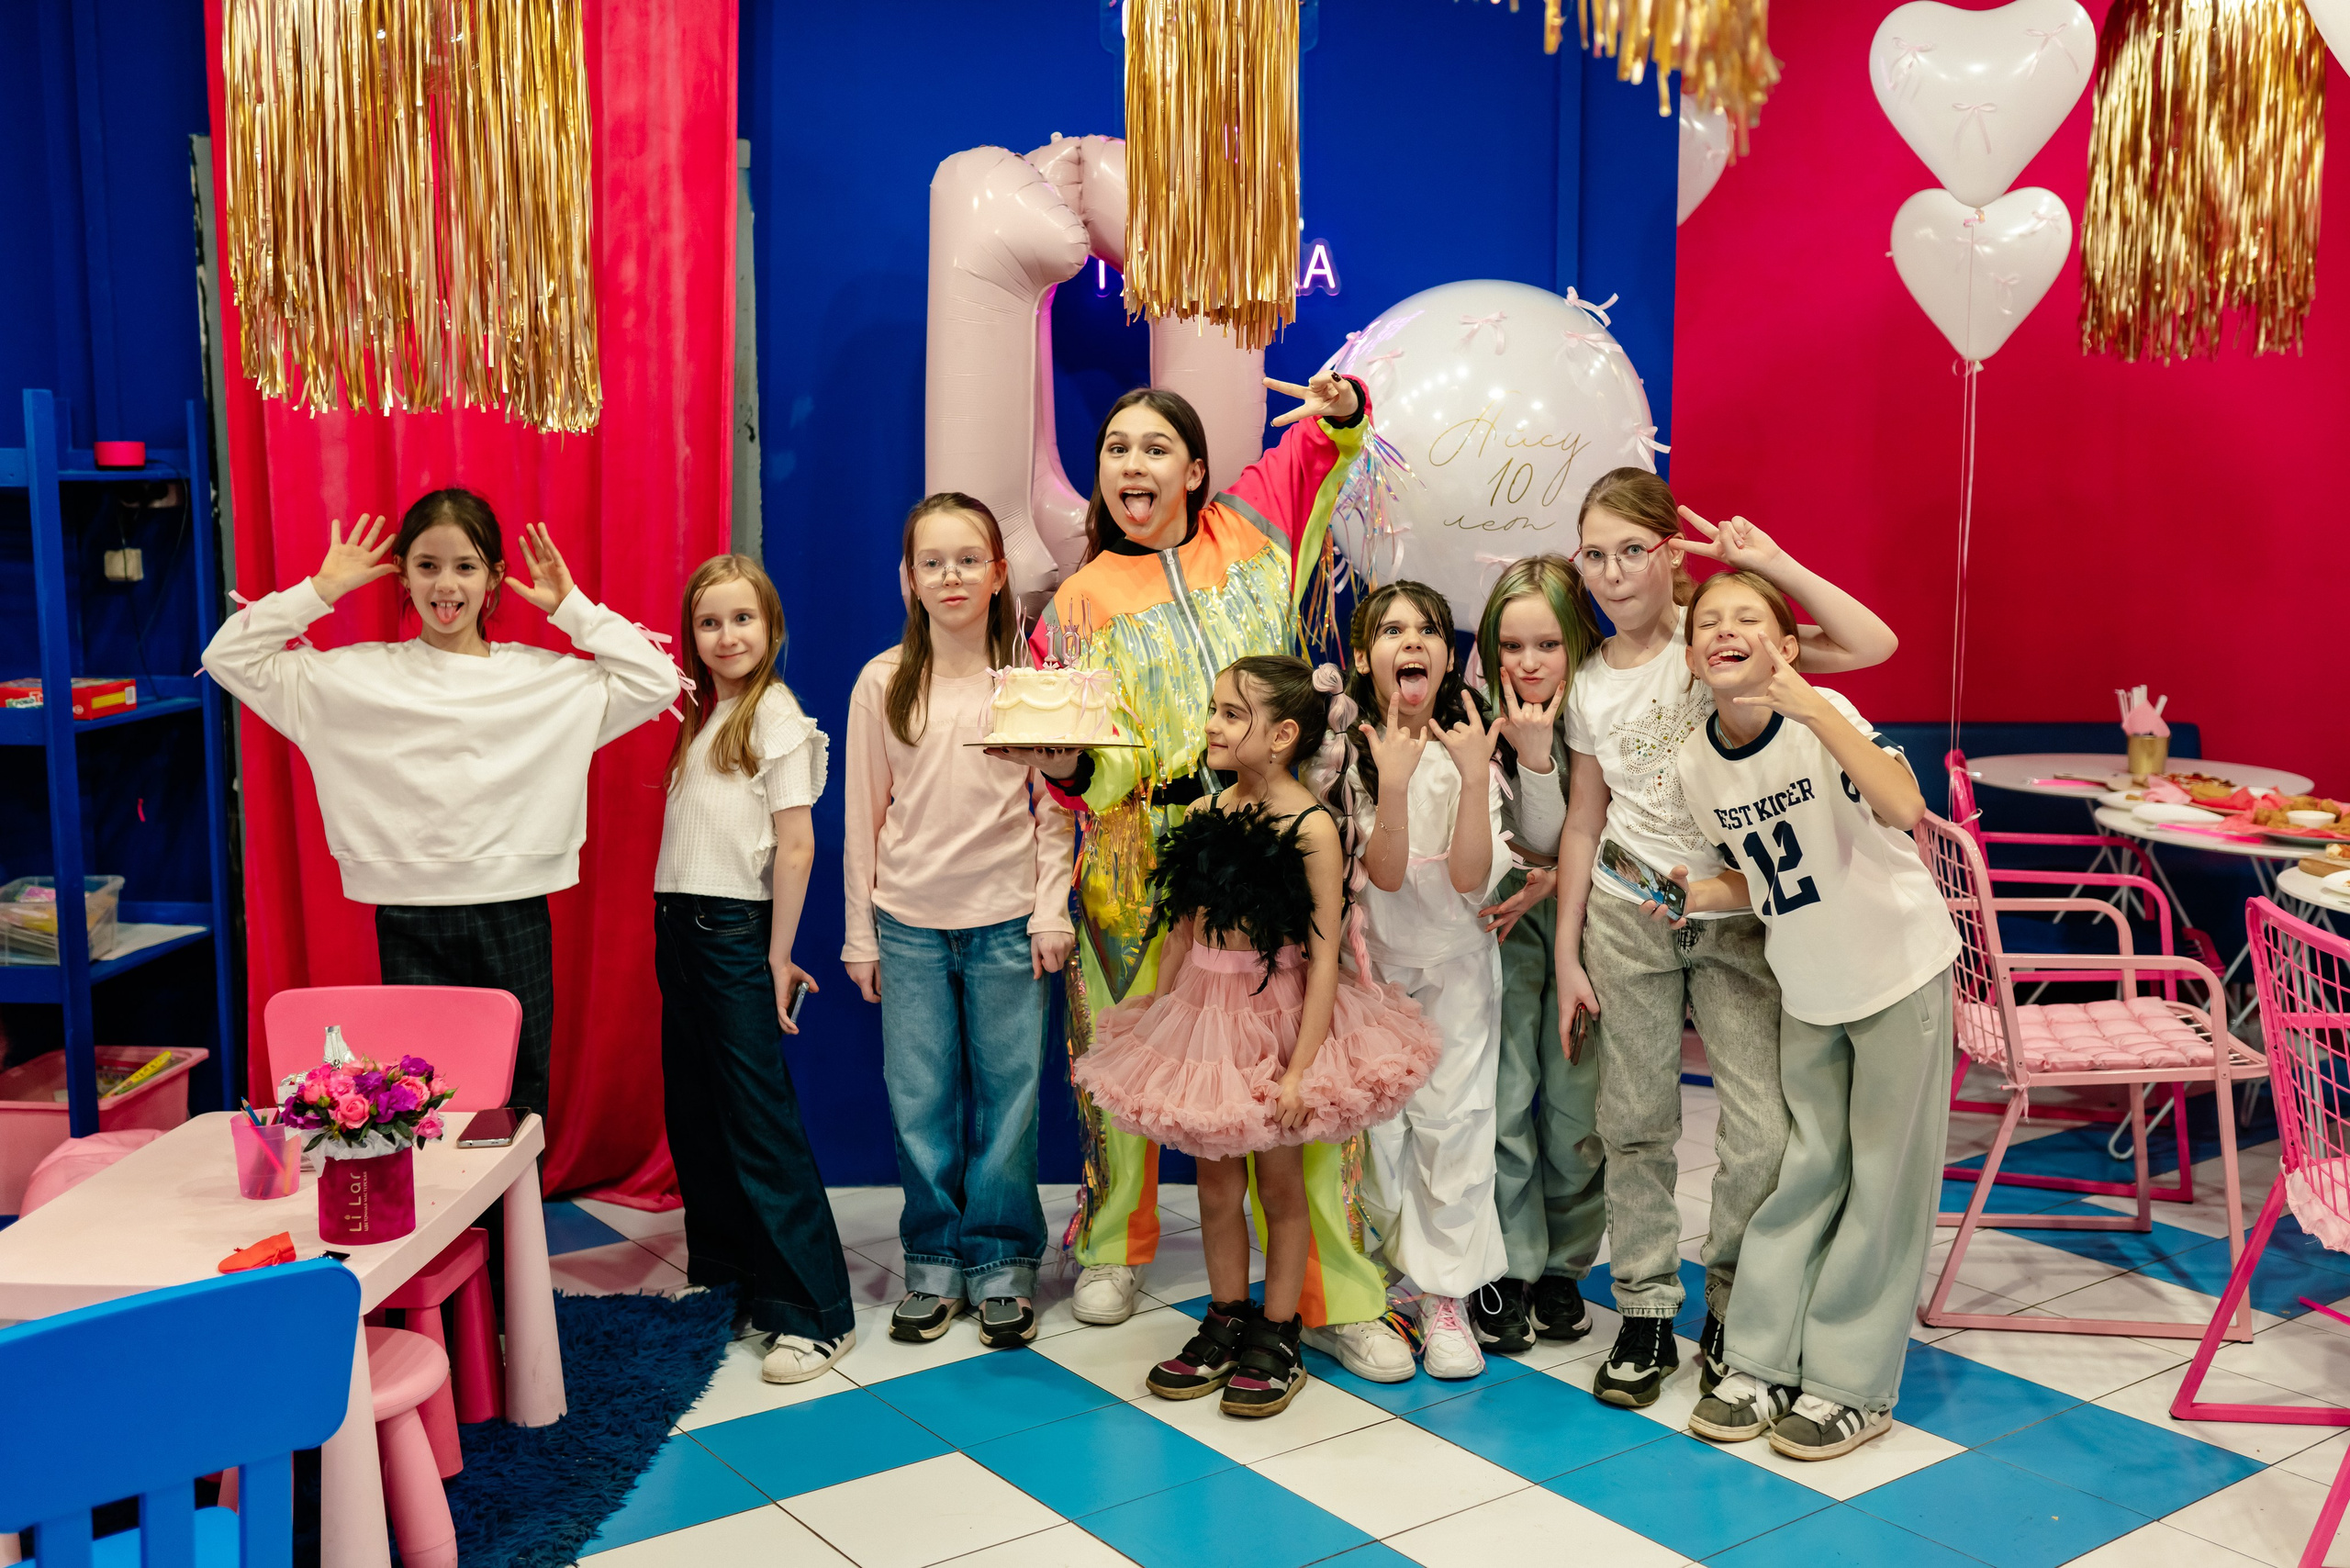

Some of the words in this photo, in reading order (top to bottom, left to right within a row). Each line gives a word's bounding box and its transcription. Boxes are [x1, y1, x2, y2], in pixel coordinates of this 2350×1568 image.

[1487, 457, 1533, 507] 10
[1713, 805, 1753, 830] EST
[1752, 778, 1815, 822] KICER
[1742, 820, 1821, 916] 12
[348, 1172, 362, 1205] Lar
[344, 1215, 362, 1232] Li
